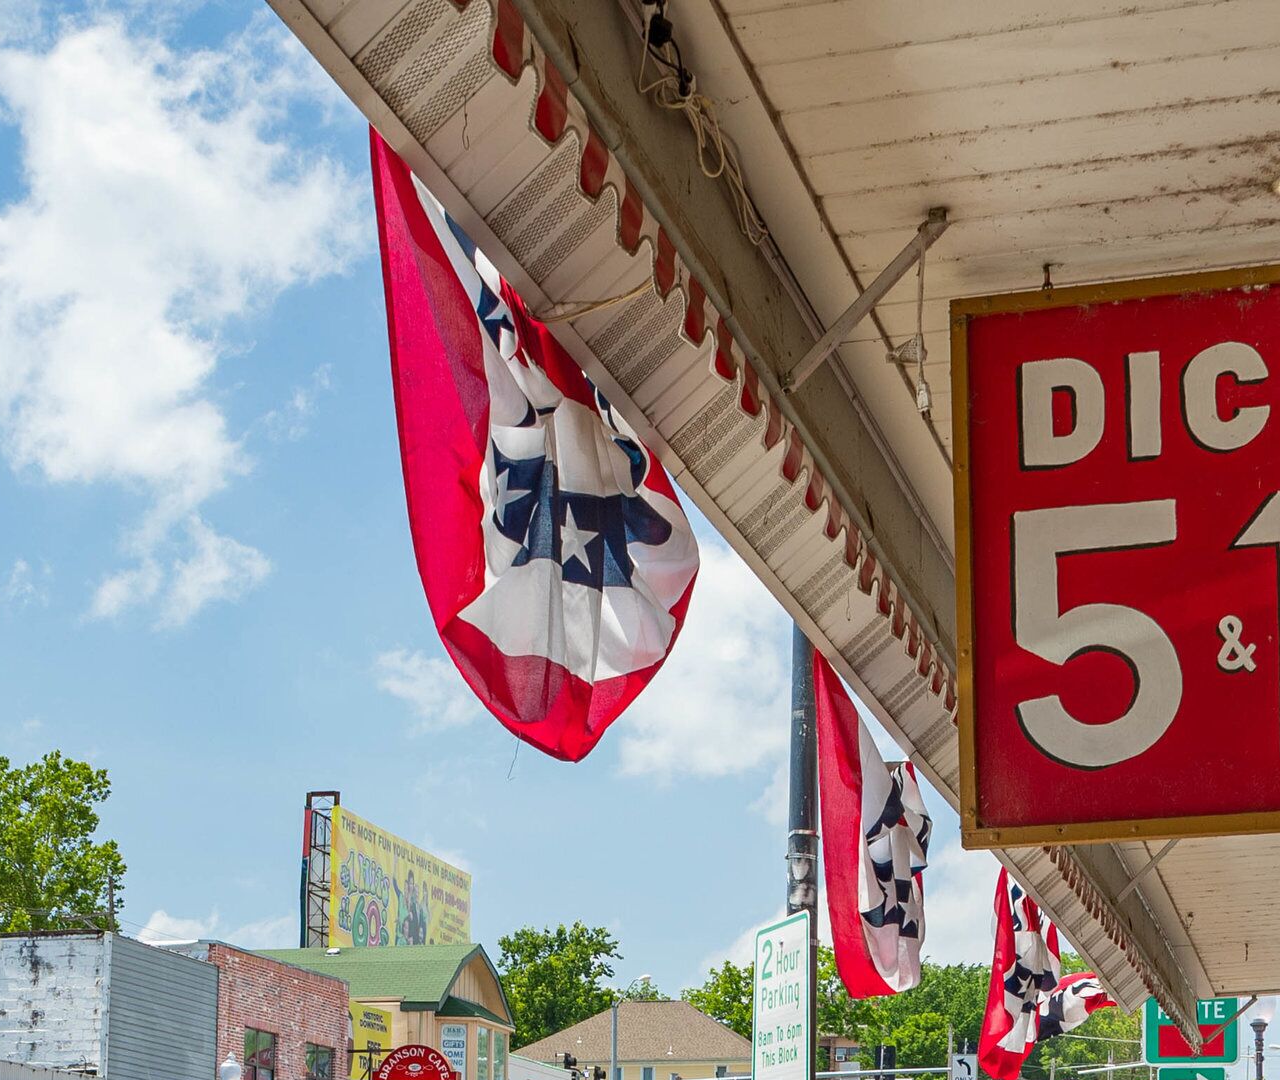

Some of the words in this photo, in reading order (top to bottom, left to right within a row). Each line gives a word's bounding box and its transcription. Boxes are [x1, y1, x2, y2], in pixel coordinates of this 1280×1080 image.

[1010, 498, 1184, 772] 5
[1216, 614, 1257, 675] &
[341, 815, 356, 835] THE
[358, 823, 376, 844] MOST
[378, 835, 392, 853] FUN
[416, 855, 432, 874] HAVE
[432, 862, 440, 877] IN
[761, 939, 773, 981] 2
[776, 948, 800, 974] Hour
[761, 980, 800, 1012] Parking
[359, 1019, 388, 1034] DOWNTOWN
[757, 1030, 773, 1047] 8am
[776, 1026, 784, 1041] To
[786, 1022, 802, 1041] 6pm
[443, 1040, 465, 1048] GIFTS
[761, 1051, 776, 1069] This
[778, 1045, 798, 1065] Block
[379, 1047, 426, 1080] BRANSON
[428, 1052, 450, 1080] CAFE
